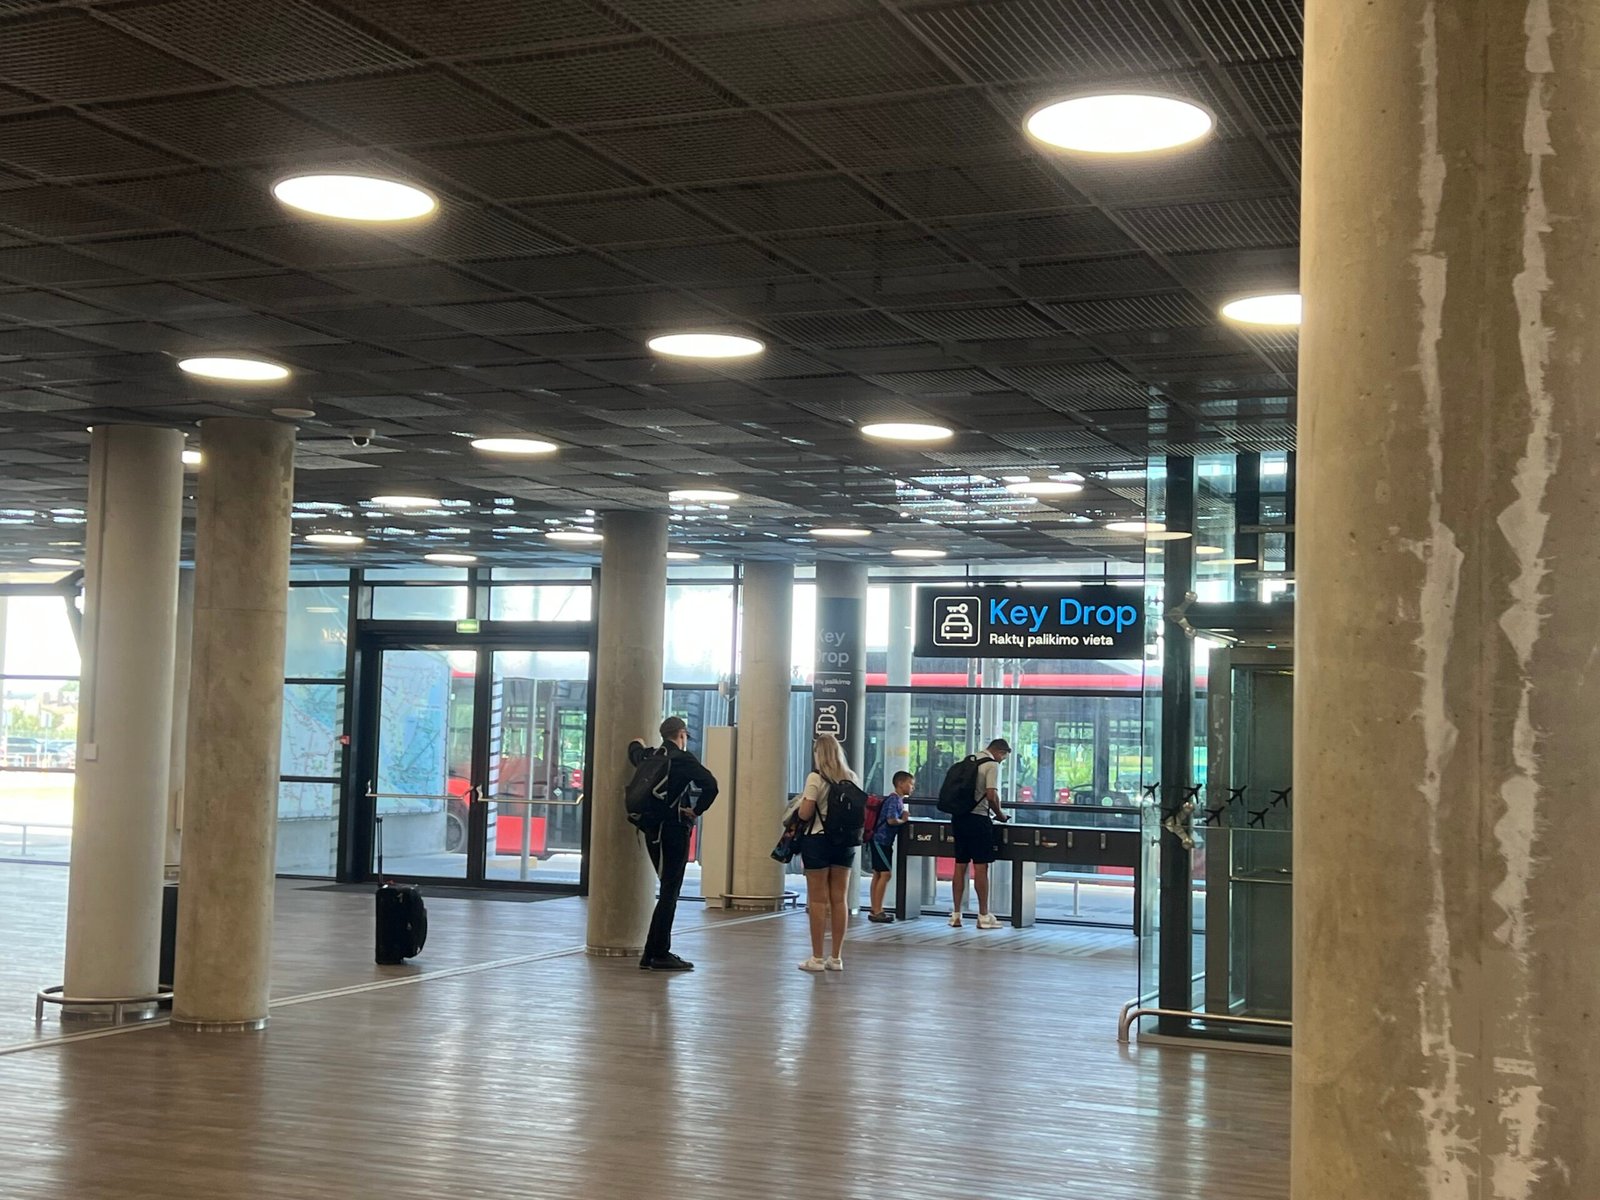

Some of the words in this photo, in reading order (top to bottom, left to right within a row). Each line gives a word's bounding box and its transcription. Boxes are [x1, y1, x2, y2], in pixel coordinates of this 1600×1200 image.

[989, 598, 1049, 633] Key
[1059, 598, 1138, 633] Drop
[989, 633, 1024, 648] Raktų
[1027, 633, 1080, 648] palikimo
[1082, 634, 1114, 646] vieta
